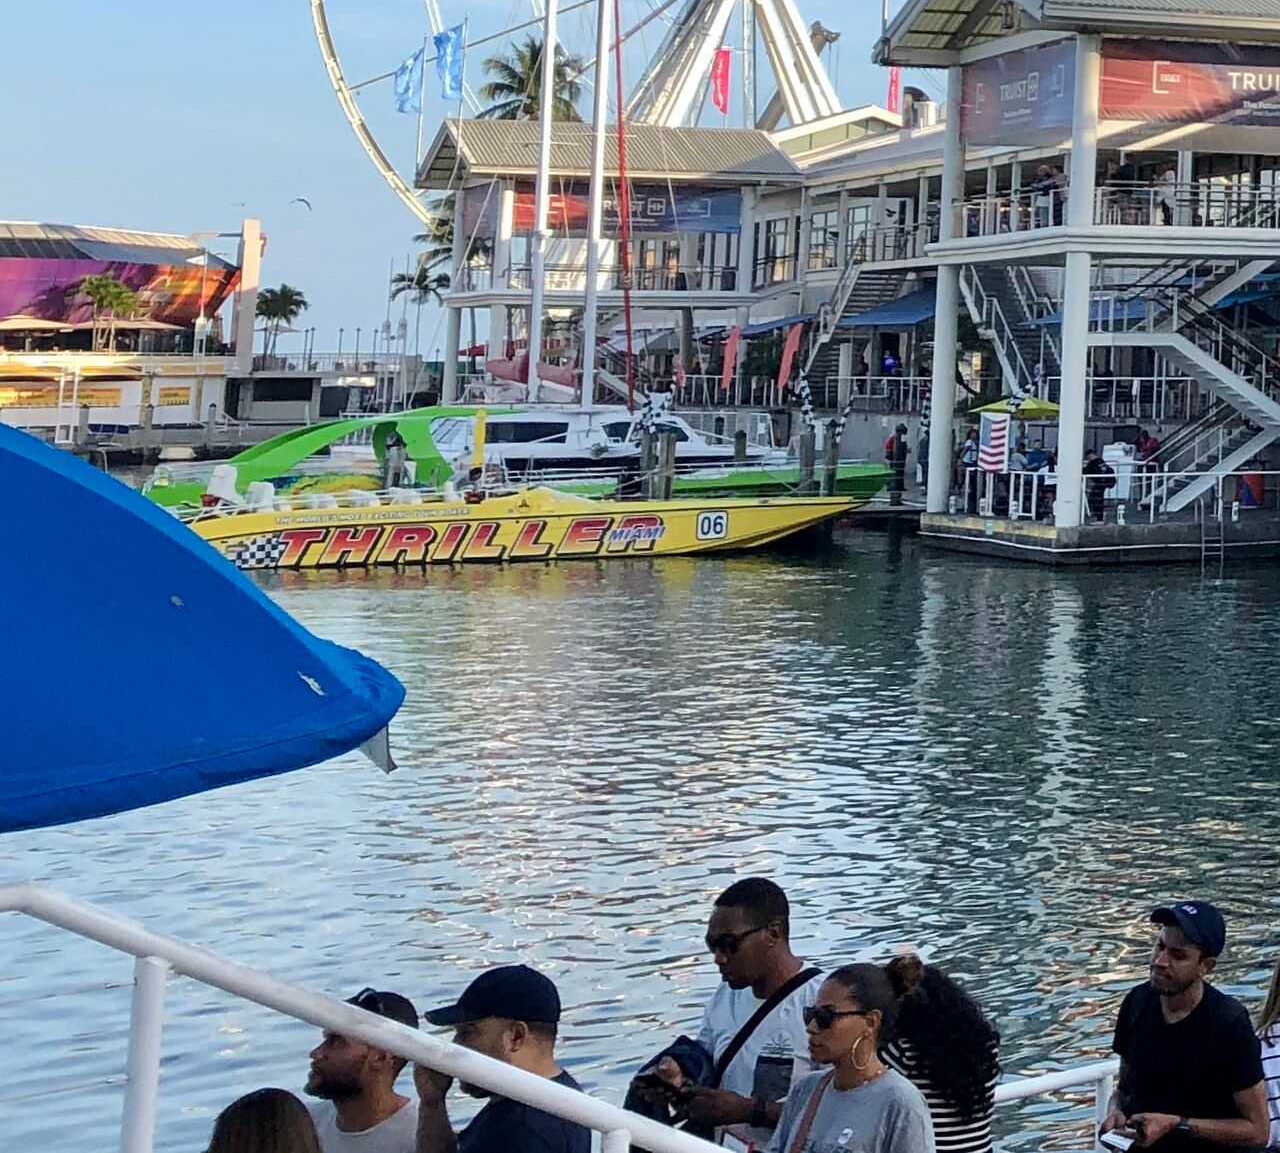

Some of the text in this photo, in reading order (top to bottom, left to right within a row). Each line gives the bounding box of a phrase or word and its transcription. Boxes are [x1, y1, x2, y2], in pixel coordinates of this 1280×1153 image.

[1000, 80, 1028, 102] TRUIST
[608, 525, 667, 543] MIAMI
[700, 515, 724, 536] 06
[276, 514, 666, 568] THRILLER
